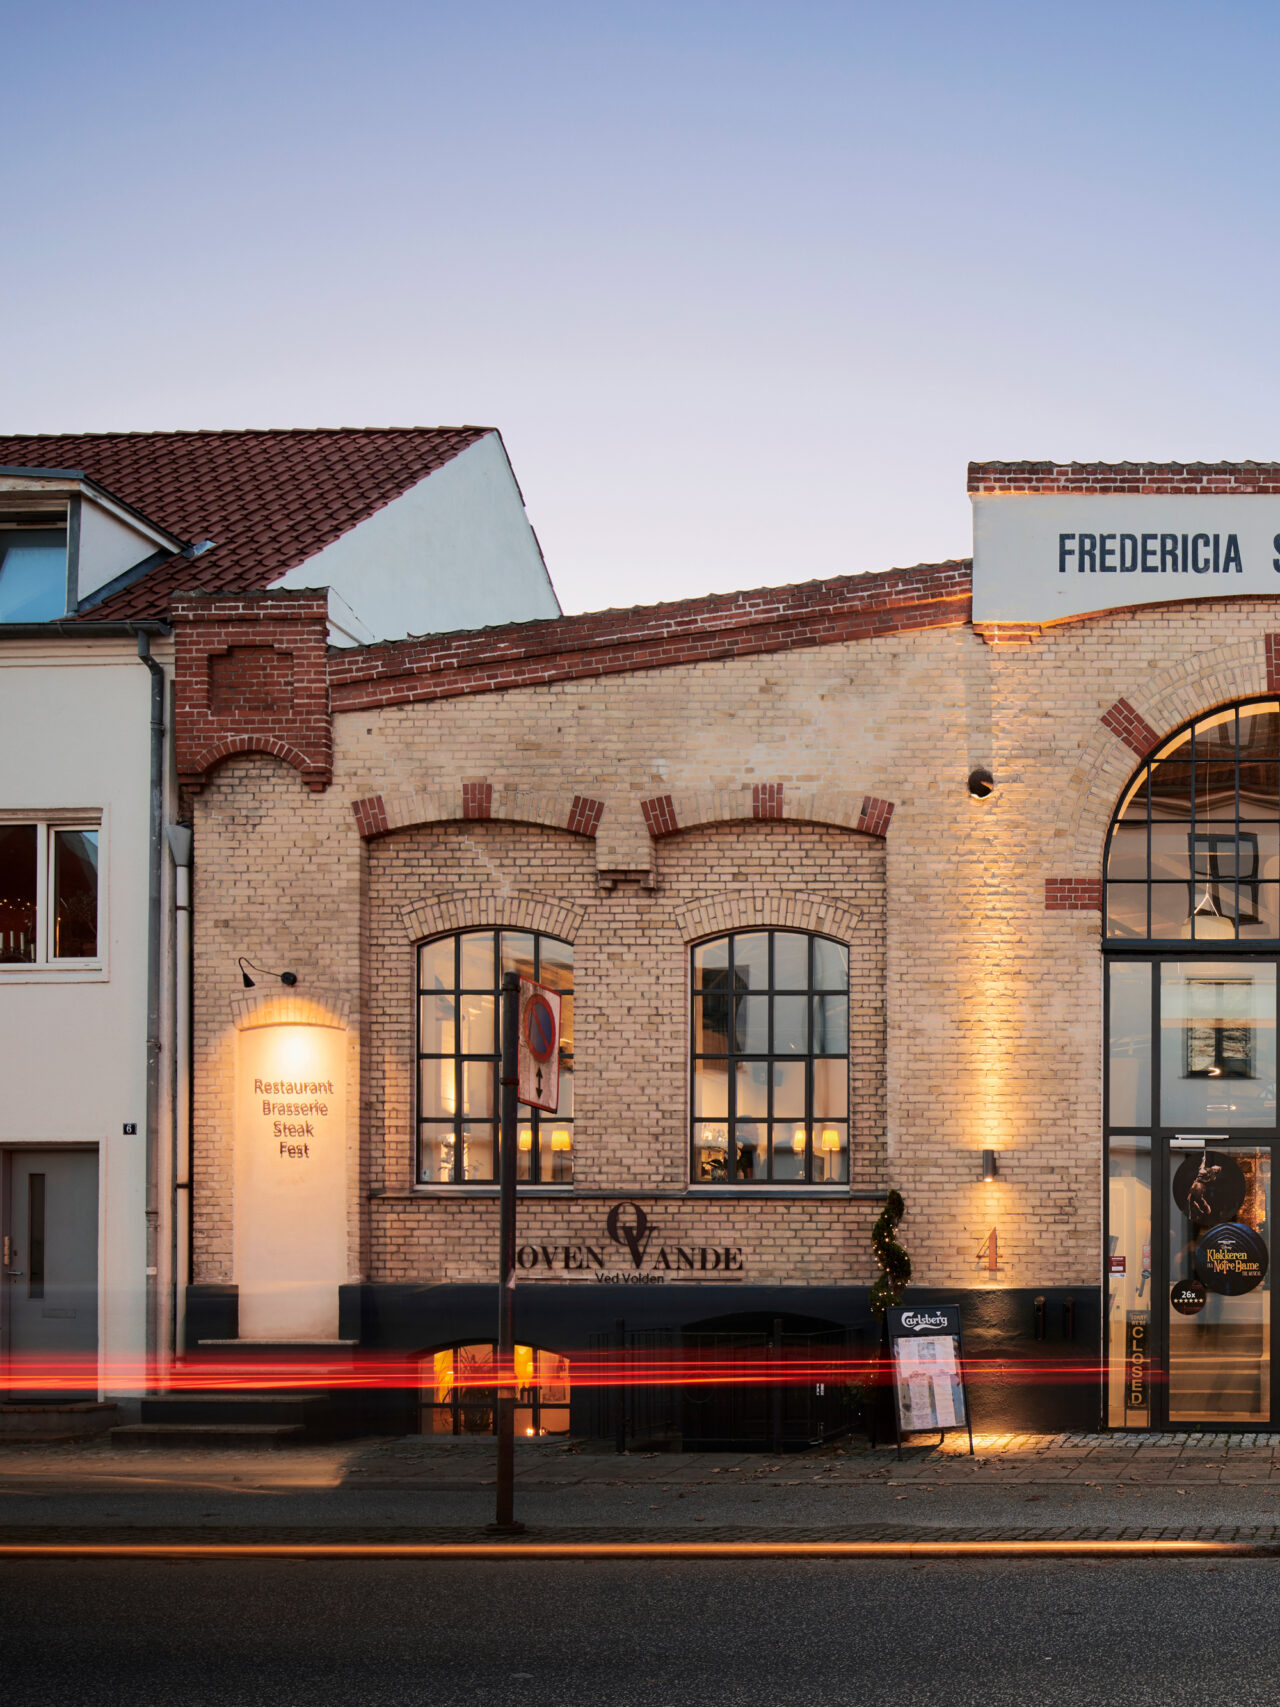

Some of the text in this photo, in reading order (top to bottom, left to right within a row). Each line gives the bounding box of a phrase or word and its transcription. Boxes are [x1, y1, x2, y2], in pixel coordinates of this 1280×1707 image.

[1058, 533, 1243, 573] FREDERICIA
[254, 1078, 334, 1095] Restaurant
[262, 1099, 328, 1117] Brasserie
[126, 1124, 132, 1133] 6
[273, 1120, 315, 1138] Steak
[279, 1141, 310, 1159] Fest
[976, 1226, 1003, 1270] 4
[516, 1246, 606, 1270] OVEN
[1214, 1260, 1260, 1274] Notre Dame
[595, 1273, 664, 1284] Ved Volden
[1181, 1290, 1196, 1298] 26x
[901, 1311, 948, 1331] Carlsberg
[1131, 1326, 1144, 1404] CLOSED
